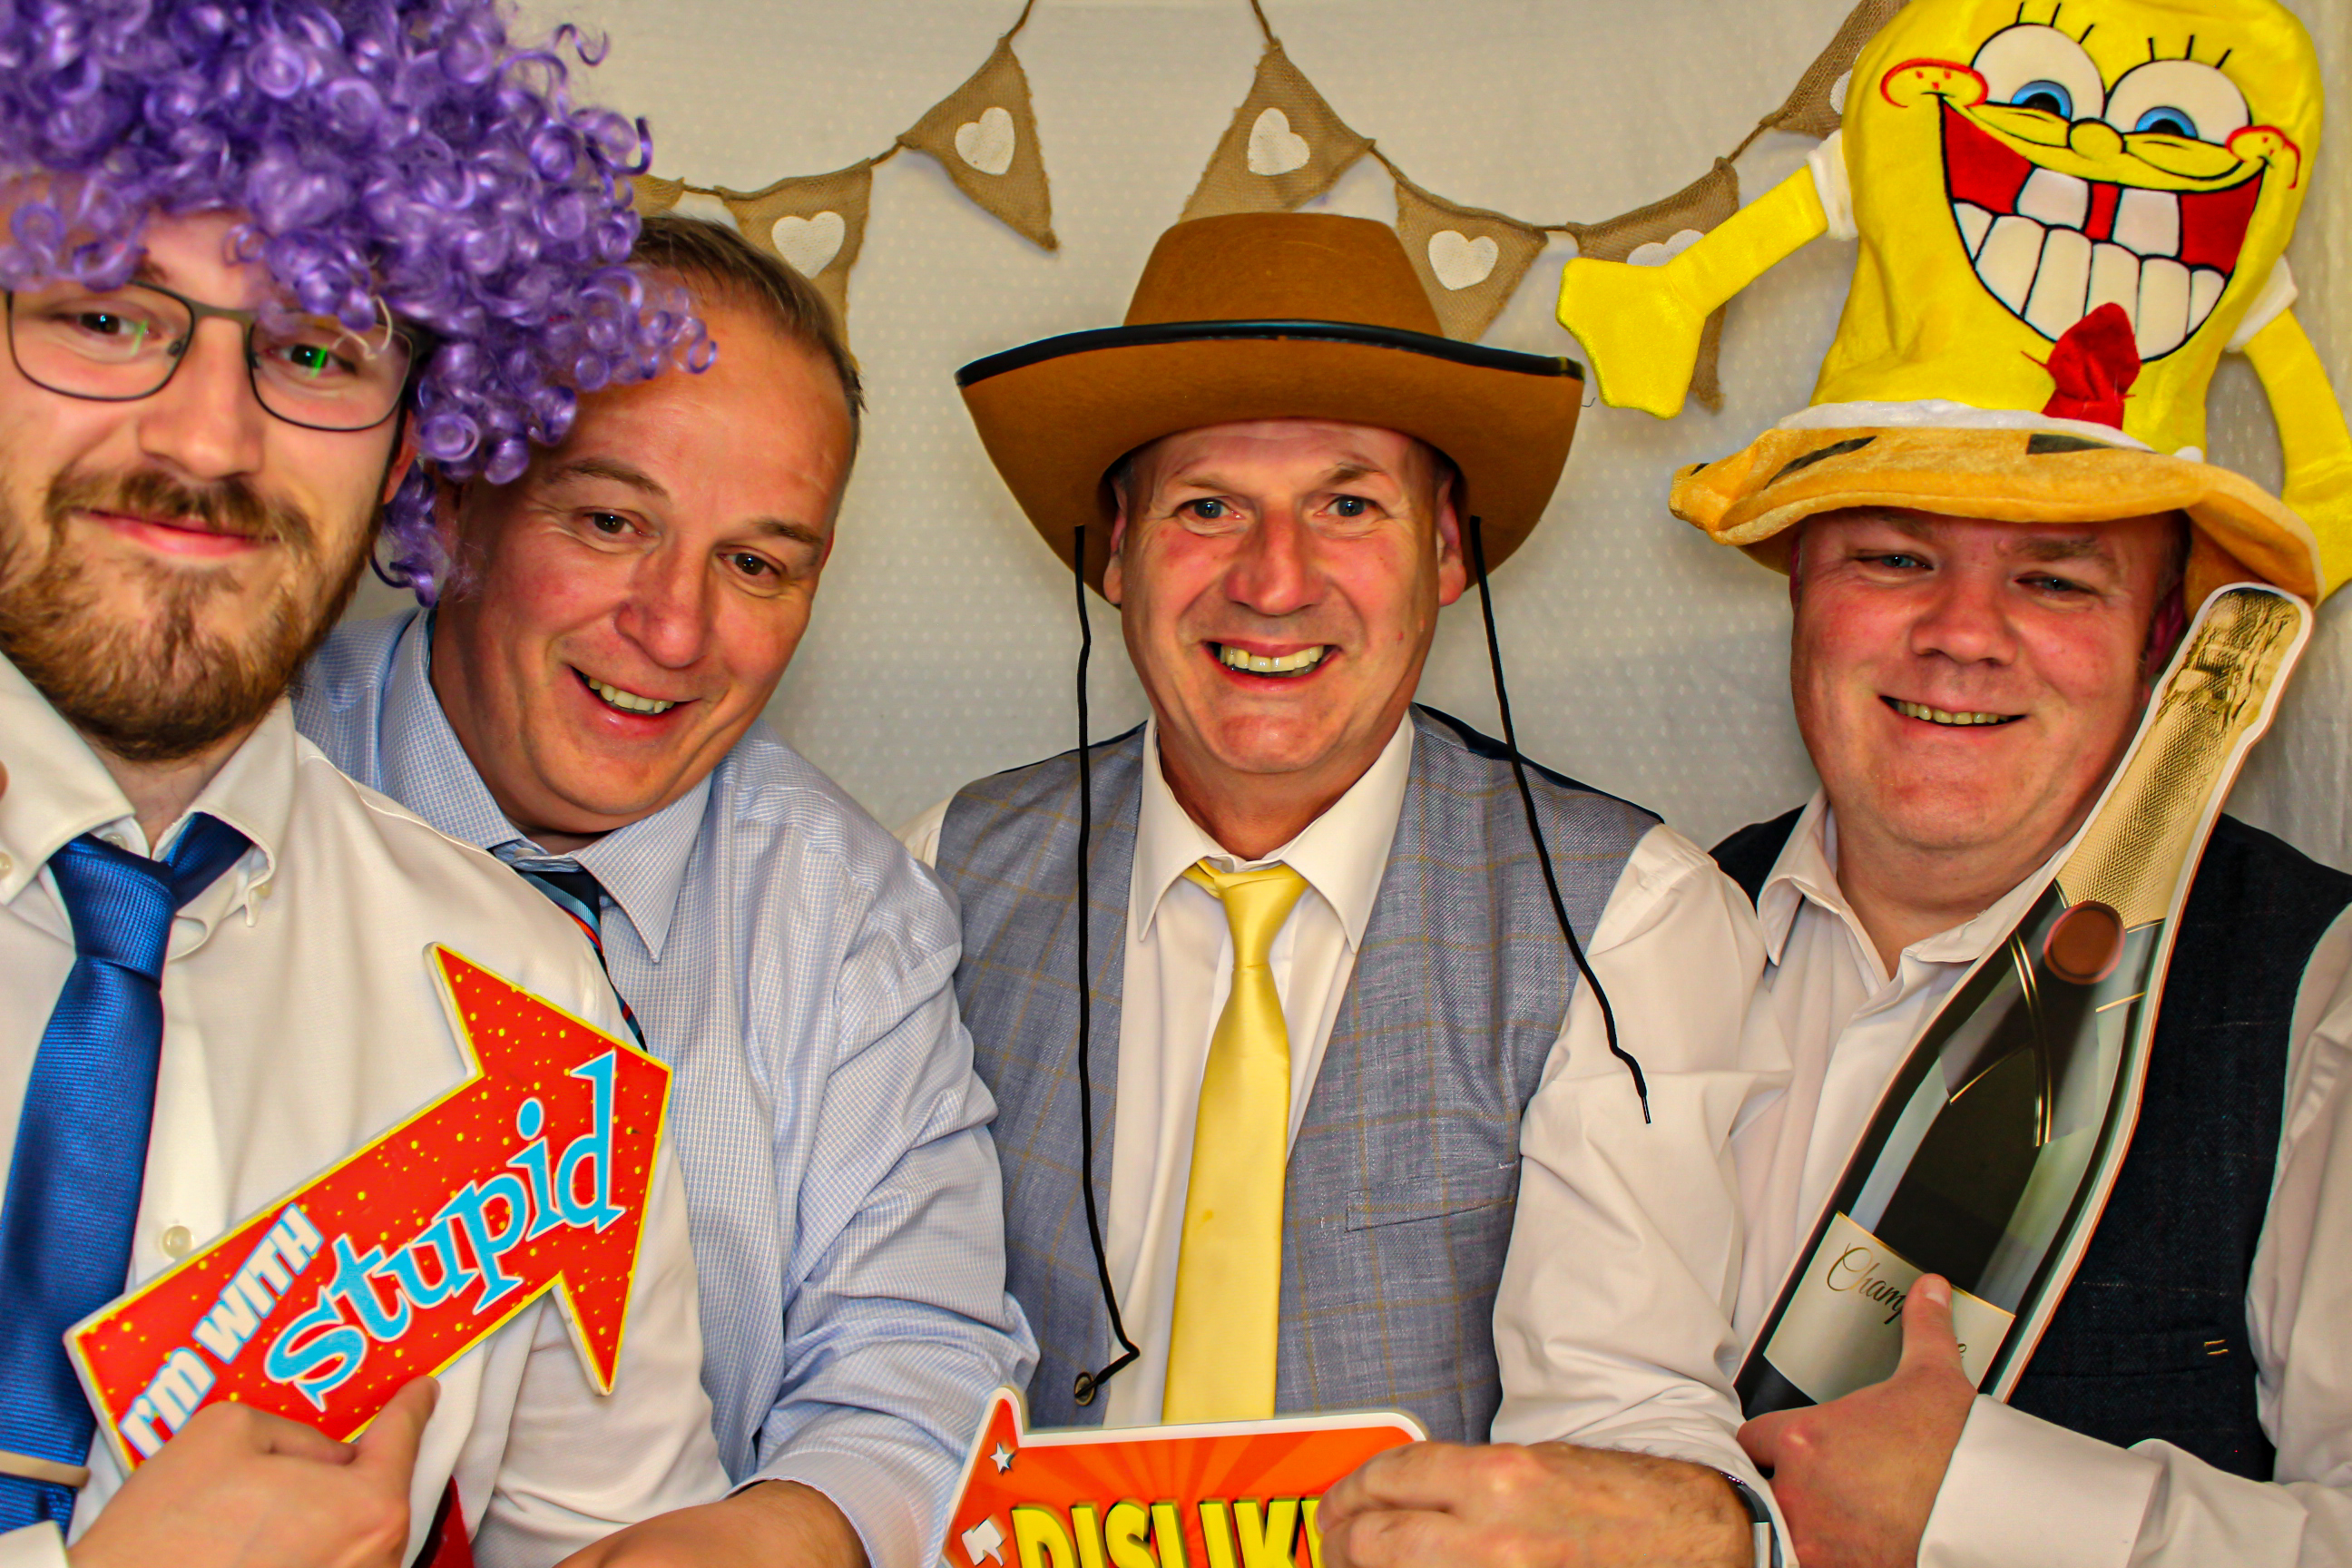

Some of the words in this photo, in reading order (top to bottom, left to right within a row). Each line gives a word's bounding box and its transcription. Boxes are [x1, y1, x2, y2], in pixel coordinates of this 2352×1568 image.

[192, 1202, 324, 1364] WITH
[264, 1050, 626, 1412] stupid
[1011, 1499, 1321, 1568] DISLIK
